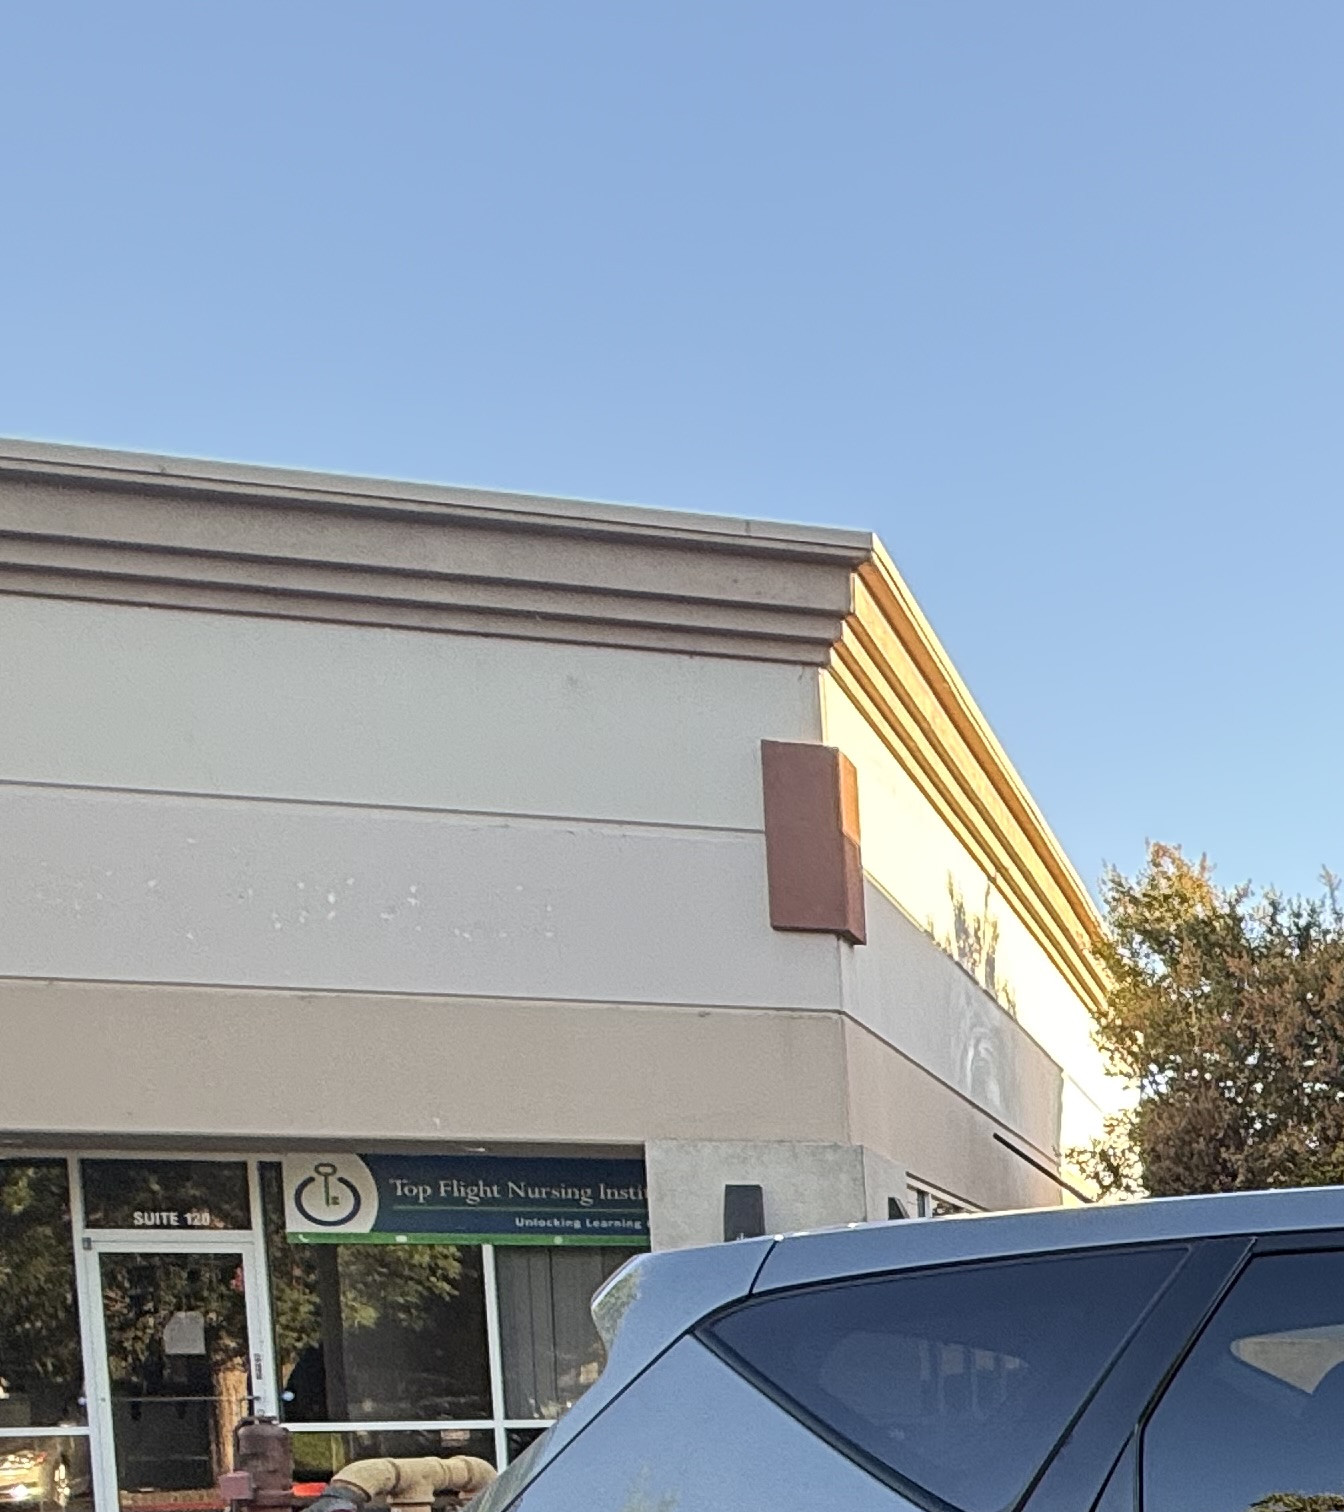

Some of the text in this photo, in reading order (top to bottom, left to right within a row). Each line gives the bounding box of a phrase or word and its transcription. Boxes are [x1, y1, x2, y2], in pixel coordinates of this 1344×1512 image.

[389, 1178, 432, 1203] Top
[439, 1179, 501, 1205] Flight
[507, 1181, 594, 1206] Nursing
[133, 1211, 179, 1226] SUITE
[586, 1217, 642, 1230] Learning
